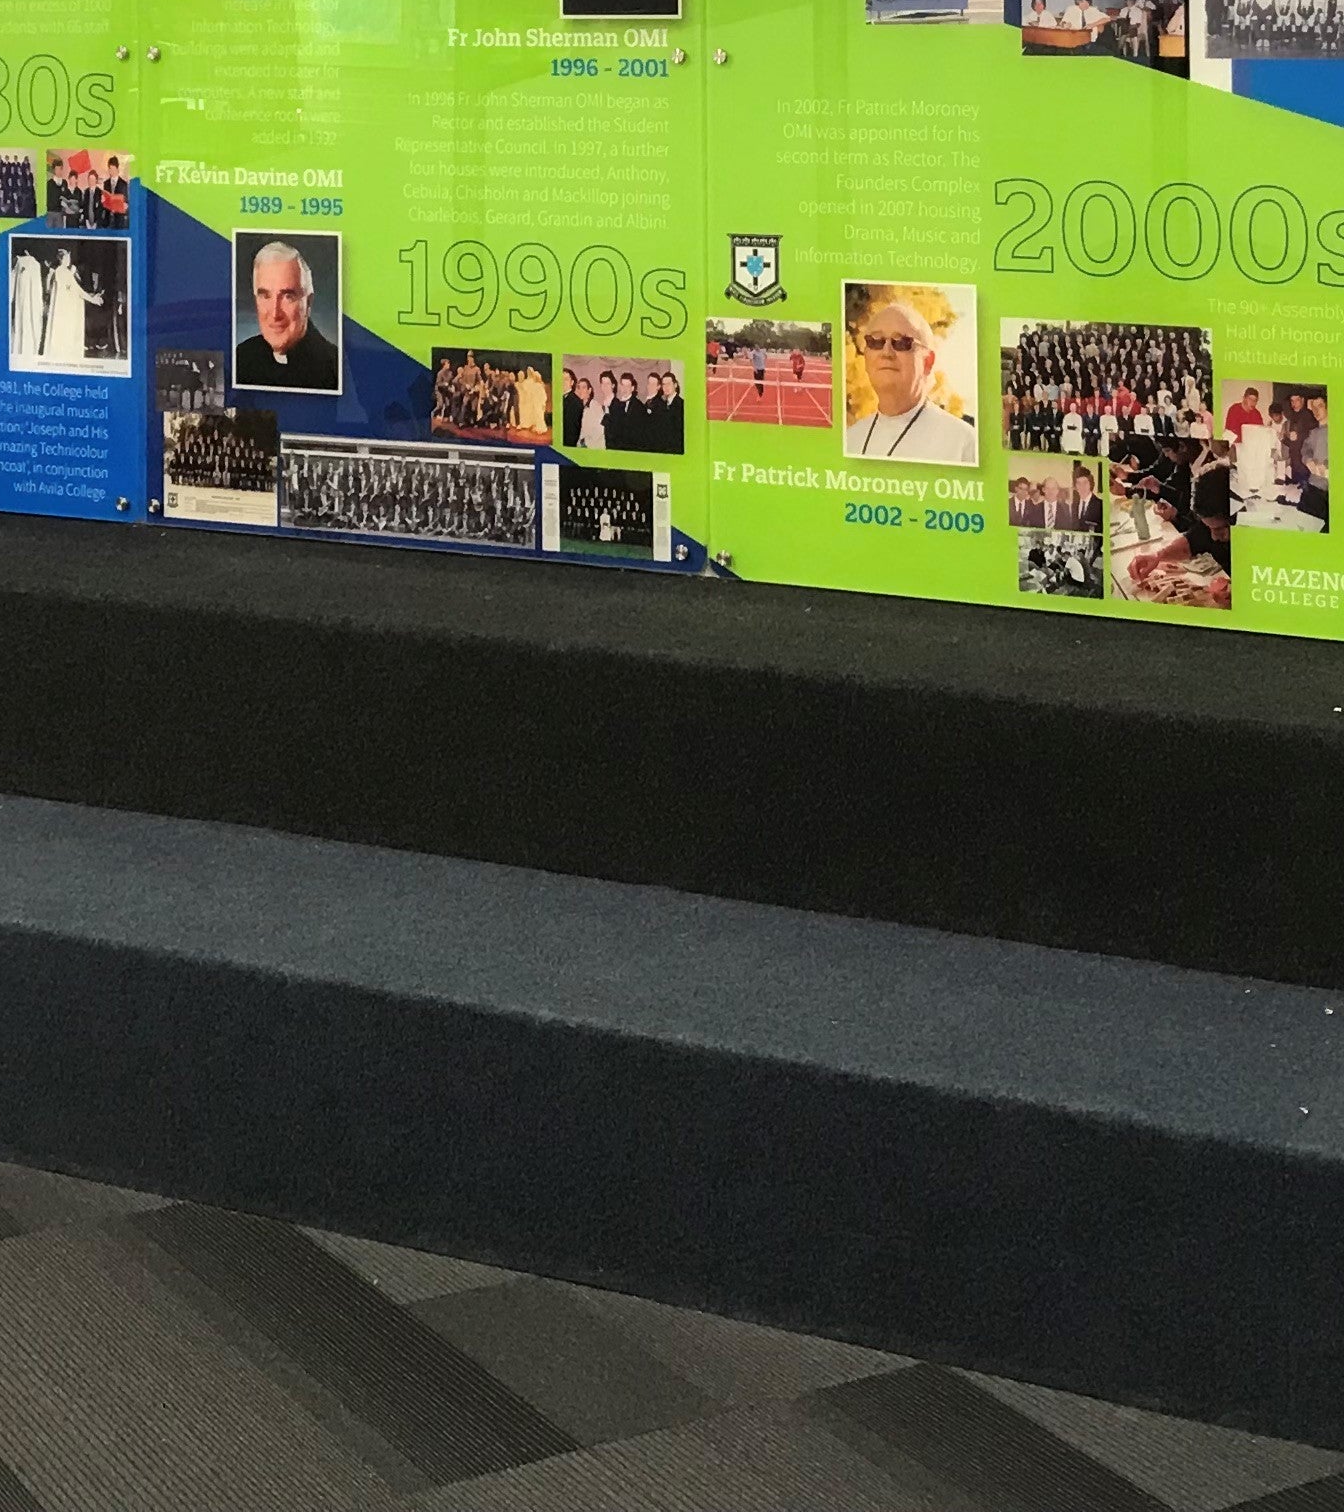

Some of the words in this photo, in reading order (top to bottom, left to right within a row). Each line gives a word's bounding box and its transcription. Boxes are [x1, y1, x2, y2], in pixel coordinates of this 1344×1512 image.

[447, 28, 468, 46] Fr
[472, 28, 521, 47] John
[525, 28, 619, 47] Sherman
[623, 28, 668, 47] OMI
[550, 58, 598, 76] 1996
[618, 58, 668, 77] 2001
[155, 166, 177, 183] Fr
[178, 166, 230, 185] Kevin
[233, 168, 299, 187] Davine
[303, 170, 343, 188] OMI
[239, 196, 282, 214] 1989
[300, 197, 343, 216] 1995
[397, 240, 688, 339] 1990s
[23, 381, 41, 395] the
[42, 383, 82, 401] College
[84, 385, 108, 399] held
[15, 403, 64, 418] inaugural
[66, 405, 108, 419] musical
[68, 425, 89, 438] and
[91, 426, 108, 439] His
[39, 442, 108, 458] Technicolour
[32, 461, 42, 473] in
[44, 464, 108, 479] conjunction
[13, 480, 36, 493] with
[38, 481, 64, 496] Avila
[65, 483, 106, 502] College
[713, 461, 736, 481] Fr
[741, 463, 820, 487] Patrick
[824, 470, 928, 499] Moroney
[934, 478, 984, 501] OMI
[845, 503, 902, 526] 2002
[924, 509, 984, 533] 2009
[1251, 588, 1339, 608] COLLEGE
